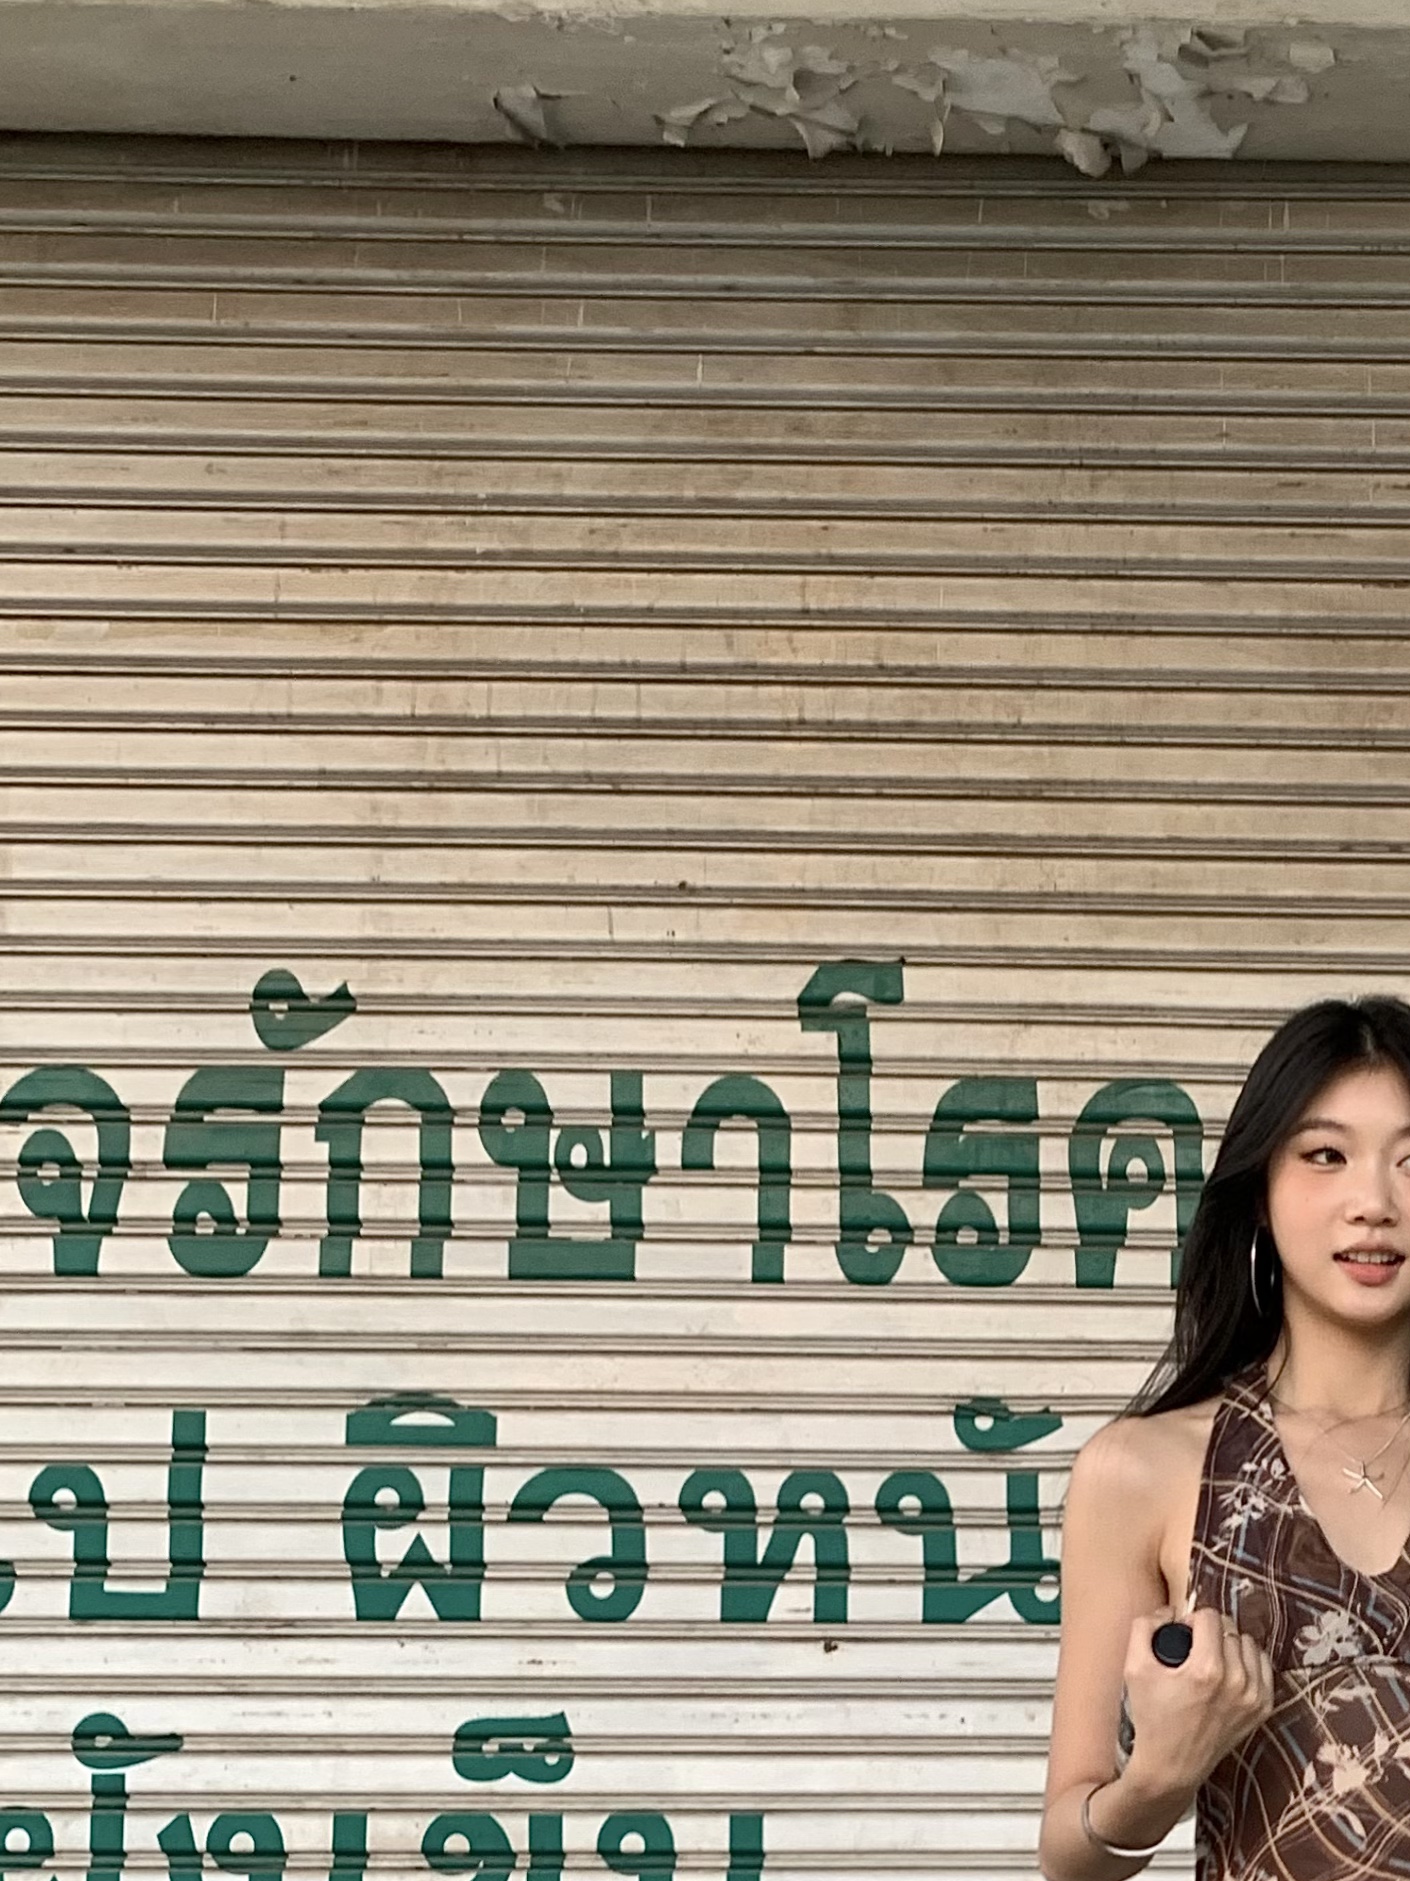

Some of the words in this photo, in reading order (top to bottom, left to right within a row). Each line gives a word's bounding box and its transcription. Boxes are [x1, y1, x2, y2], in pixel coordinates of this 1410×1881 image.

[0, 1408, 208, 1622] ป
[341, 1390, 1063, 1624] ผิวหนั
